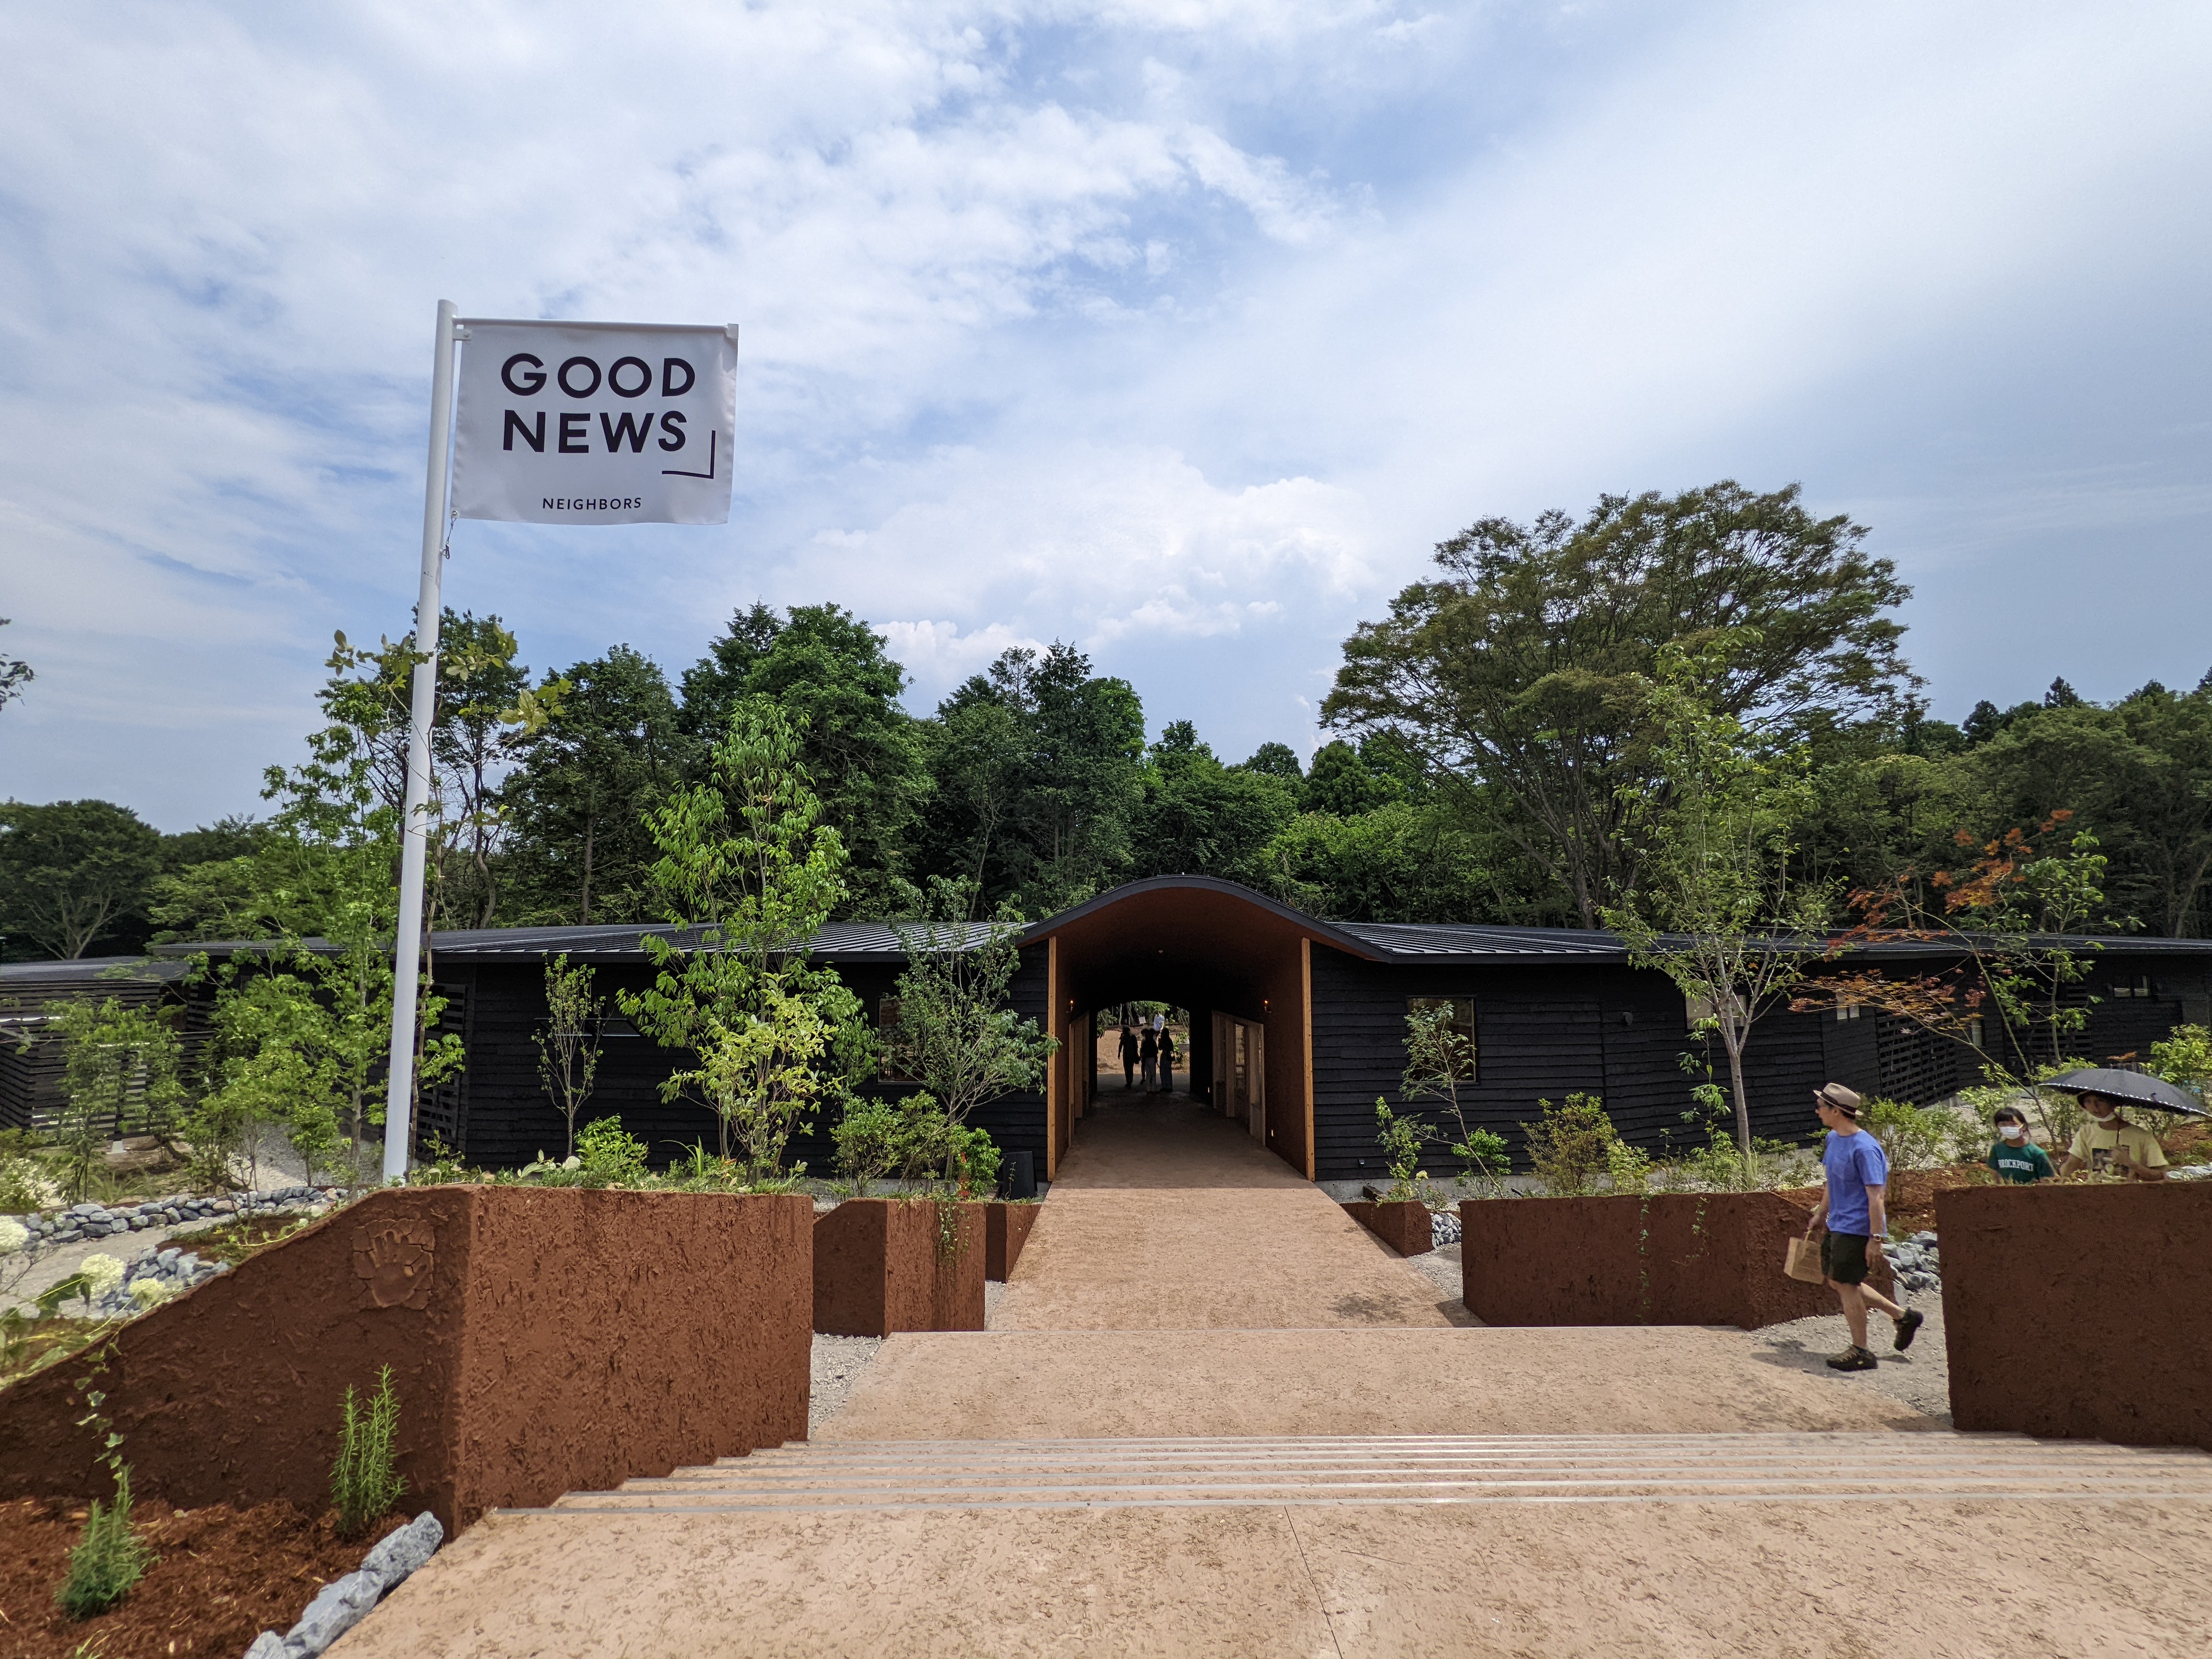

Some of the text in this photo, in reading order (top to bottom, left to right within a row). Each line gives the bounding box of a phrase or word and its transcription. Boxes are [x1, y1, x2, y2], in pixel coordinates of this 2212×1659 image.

[501, 353, 696, 399] GOOD
[503, 409, 687, 454] NEWS
[542, 497, 642, 510] NEIGHBORS
